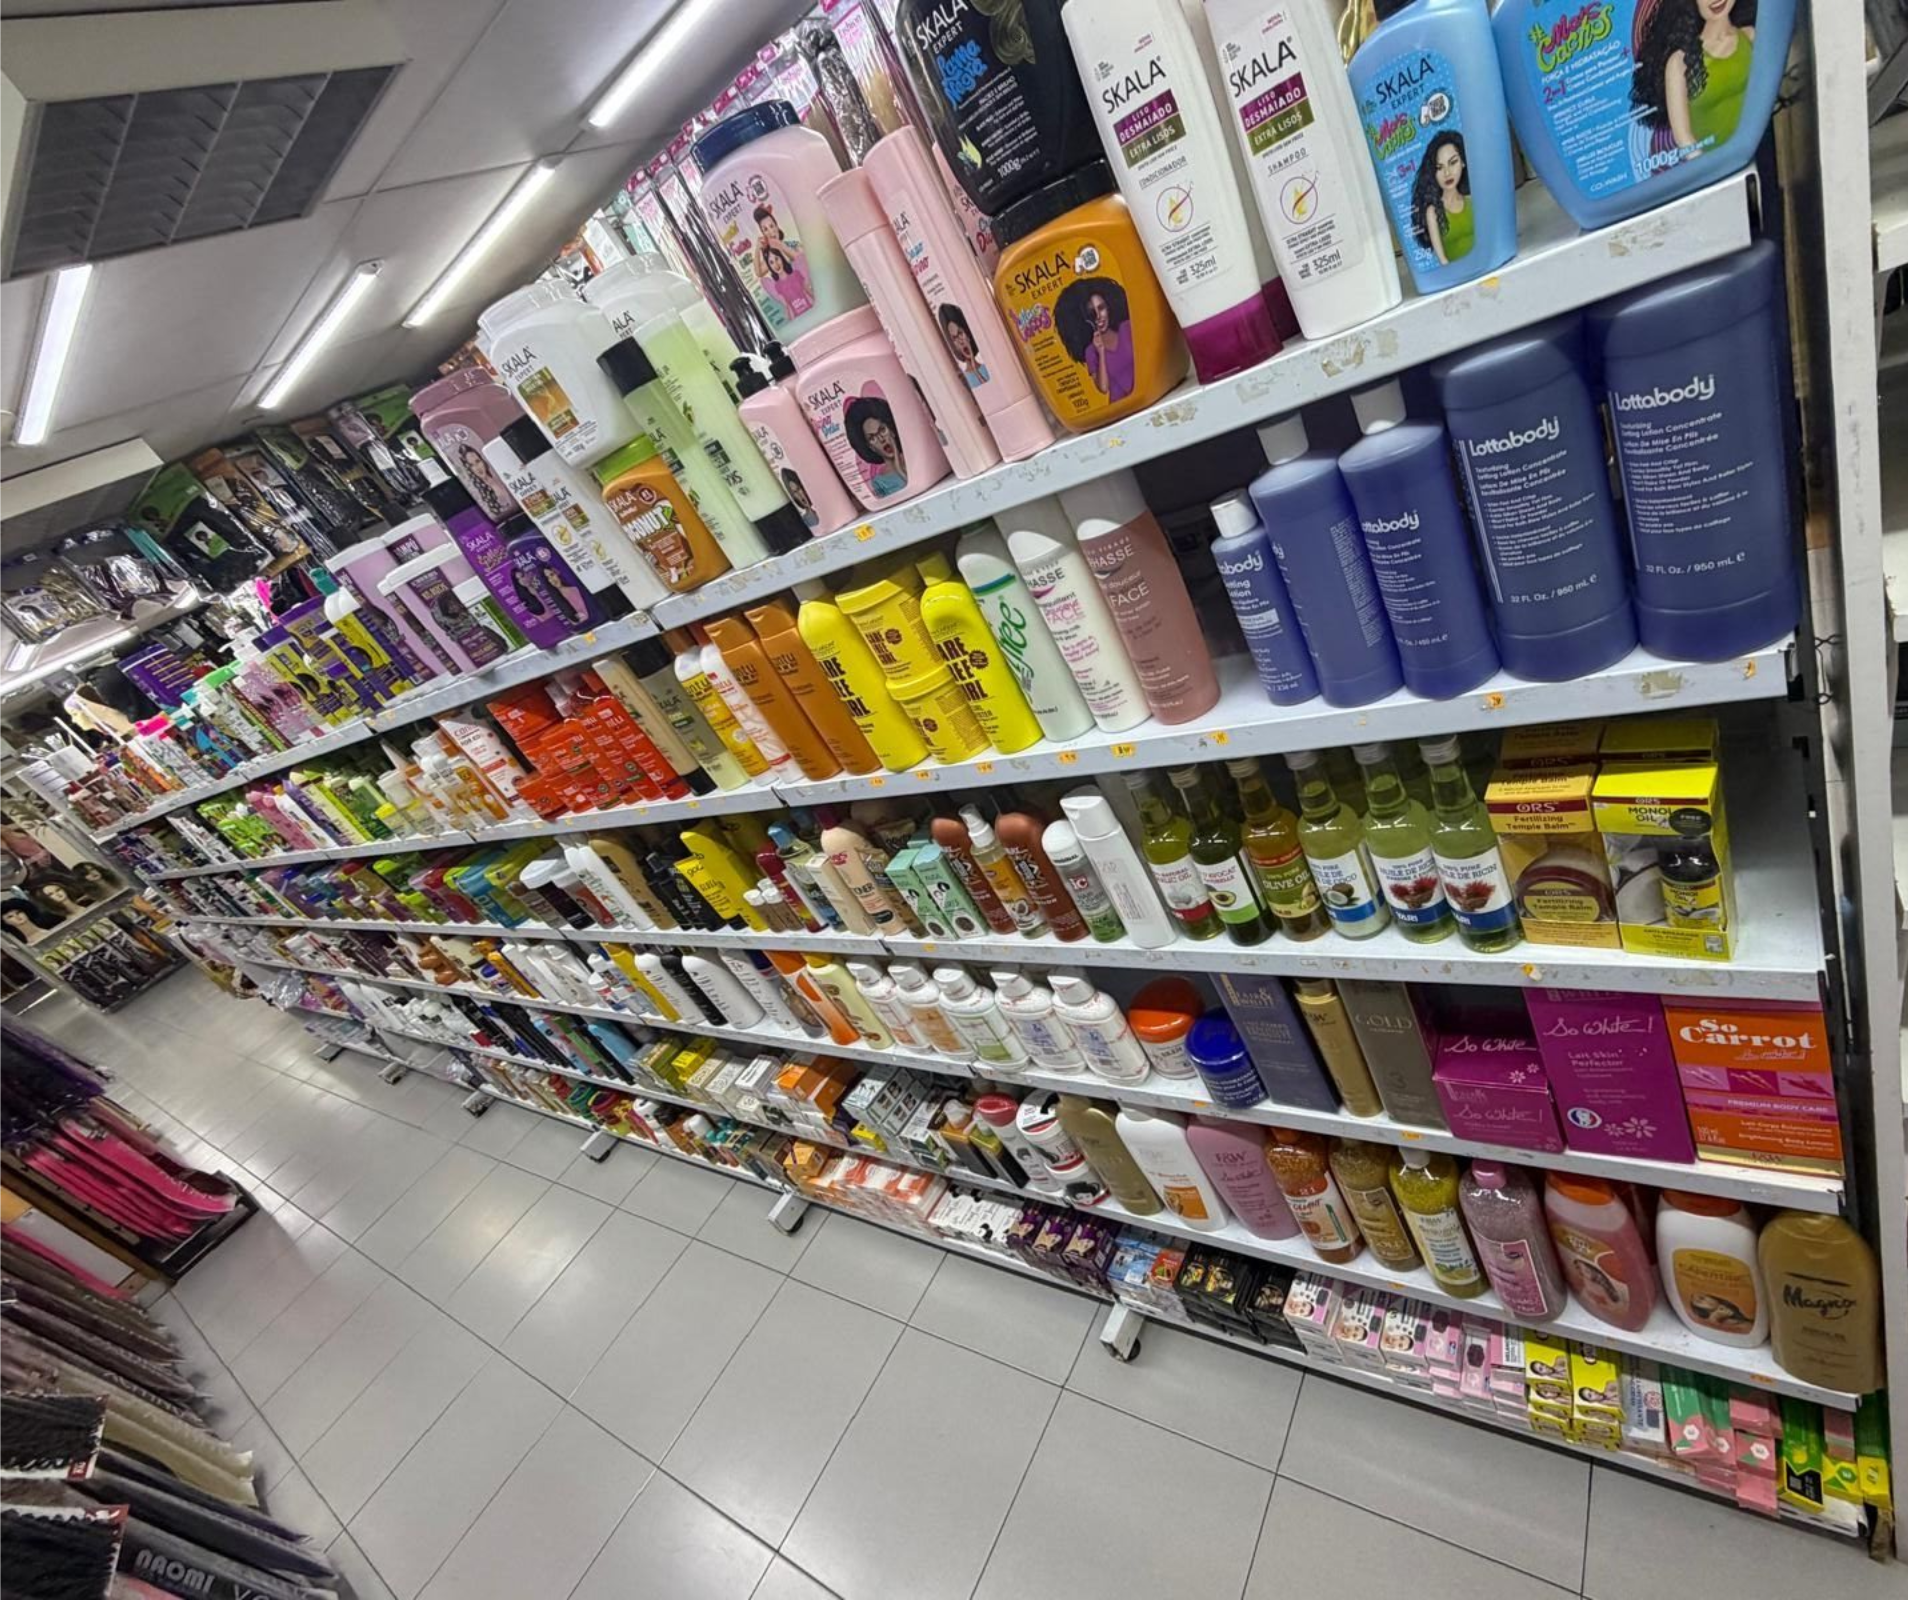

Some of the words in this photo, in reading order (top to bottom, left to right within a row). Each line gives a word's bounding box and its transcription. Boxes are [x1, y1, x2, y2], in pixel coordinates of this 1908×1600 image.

[933, 21, 963, 54] EXPERT
[1230, 38, 1297, 98] SKALA
[1376, 57, 1434, 104] SKALA
[1102, 59, 1166, 114] SKALA
[1391, 84, 1424, 110] EXPERT
[1244, 87, 1301, 128] DESMAIADO
[1120, 103, 1172, 142] DESMAIADO
[1254, 128, 1277, 145] EXTRA
[1279, 111, 1302, 131] LISOS
[1129, 141, 1152, 159] EXTRA
[1152, 125, 1175, 144] LISOS
[1268, 147, 1306, 174] SHAMPOO
[709, 182, 744, 220] SKALA
[1014, 253, 1070, 294] SKALA
[1031, 276, 1063, 300] EXPERT
[502, 348, 536, 377] SKALA
[808, 382, 845, 410] SKALA
[1110, 583, 1150, 608] FACE
[1514, 814, 1563, 824] Fertilizing
[1516, 803, 1556, 813] ORS
[1506, 822, 1541, 833] Temple
[1544, 820, 1568, 831] Balm
[1473, 864, 1498, 879] RICIN
[1355, 1013, 1412, 1029] GOLD
[1543, 1018, 1579, 1037] So
[1699, 1018, 1739, 1033] So
[1444, 1036, 1478, 1053] So
[1679, 1026, 1818, 1050] Carrot
[1454, 1104, 1482, 1119] So
[1728, 1098, 1772, 1108] PREMIUM
[1773, 1102, 1800, 1111] BODY
[134, 1549, 215, 1593] NAOMI
